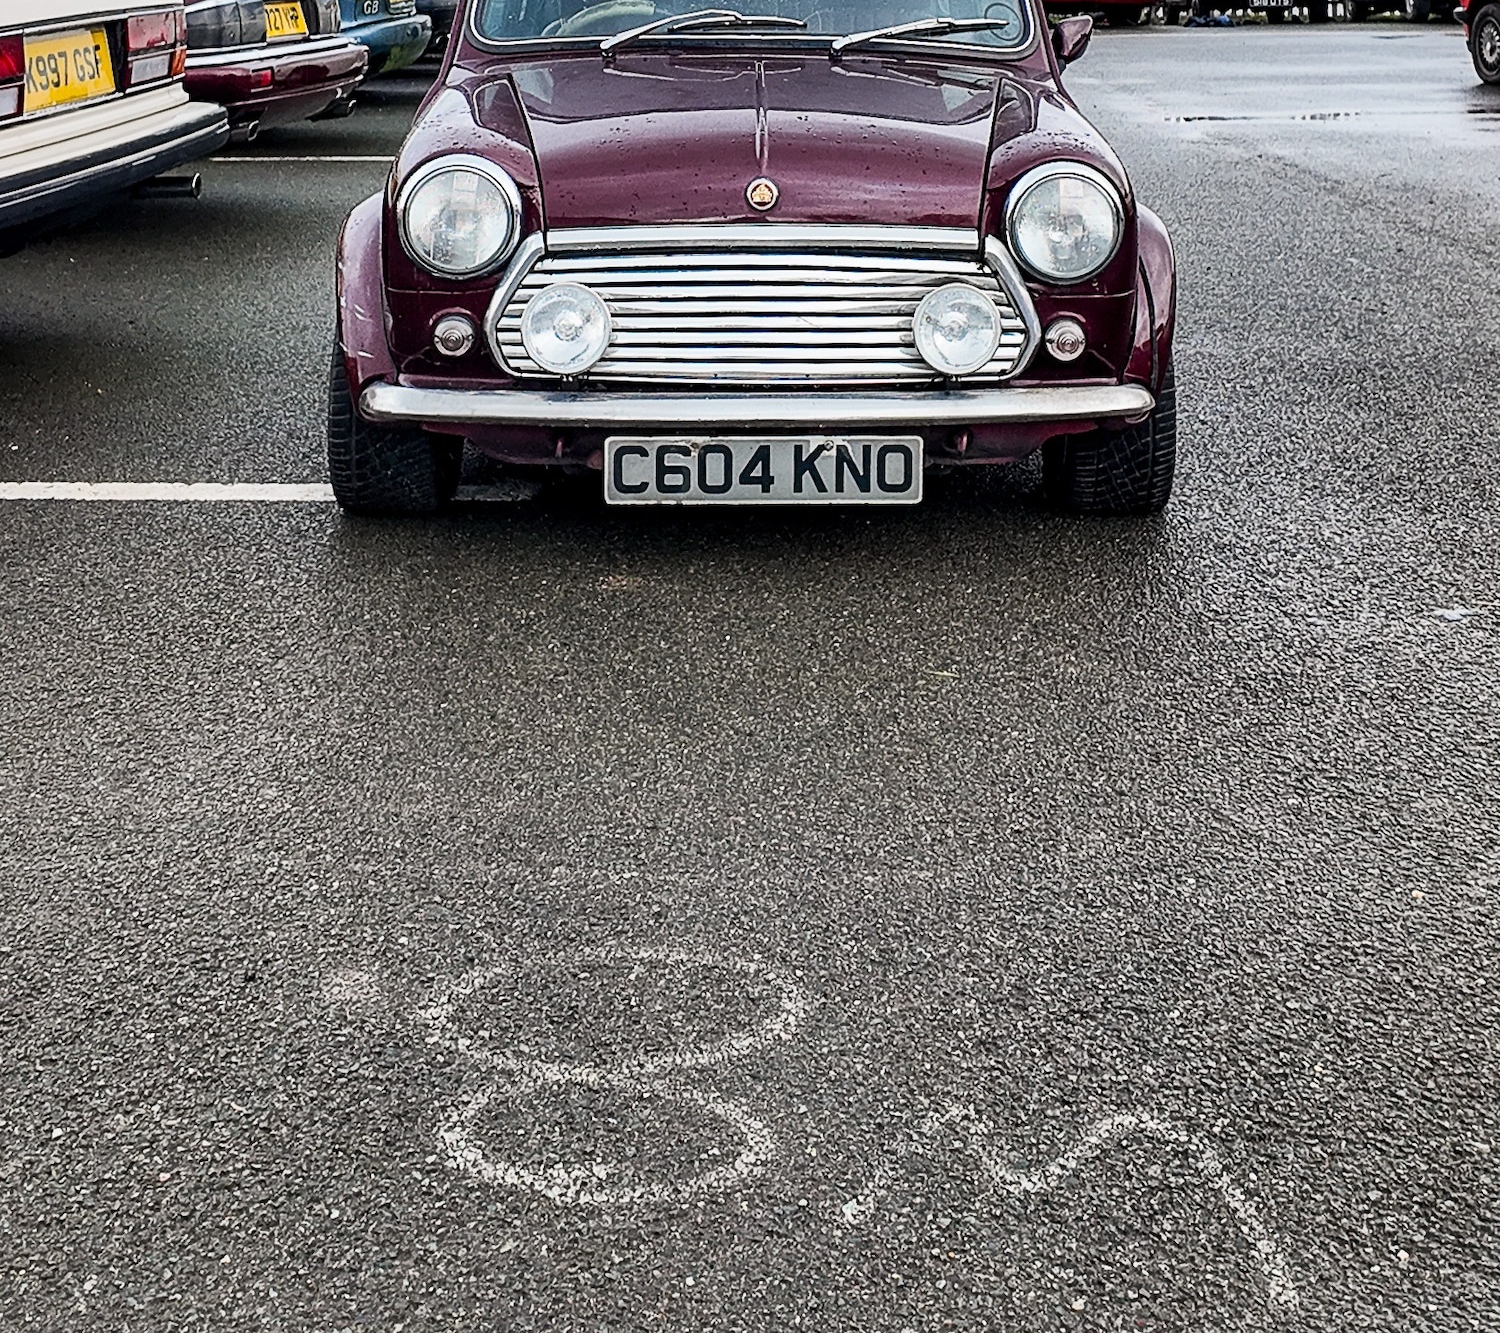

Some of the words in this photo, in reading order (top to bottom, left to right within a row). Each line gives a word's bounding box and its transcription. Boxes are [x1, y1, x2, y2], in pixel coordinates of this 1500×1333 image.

[363, 0, 379, 14] GB
[613, 444, 775, 494] C604
[793, 444, 913, 494] KNO
